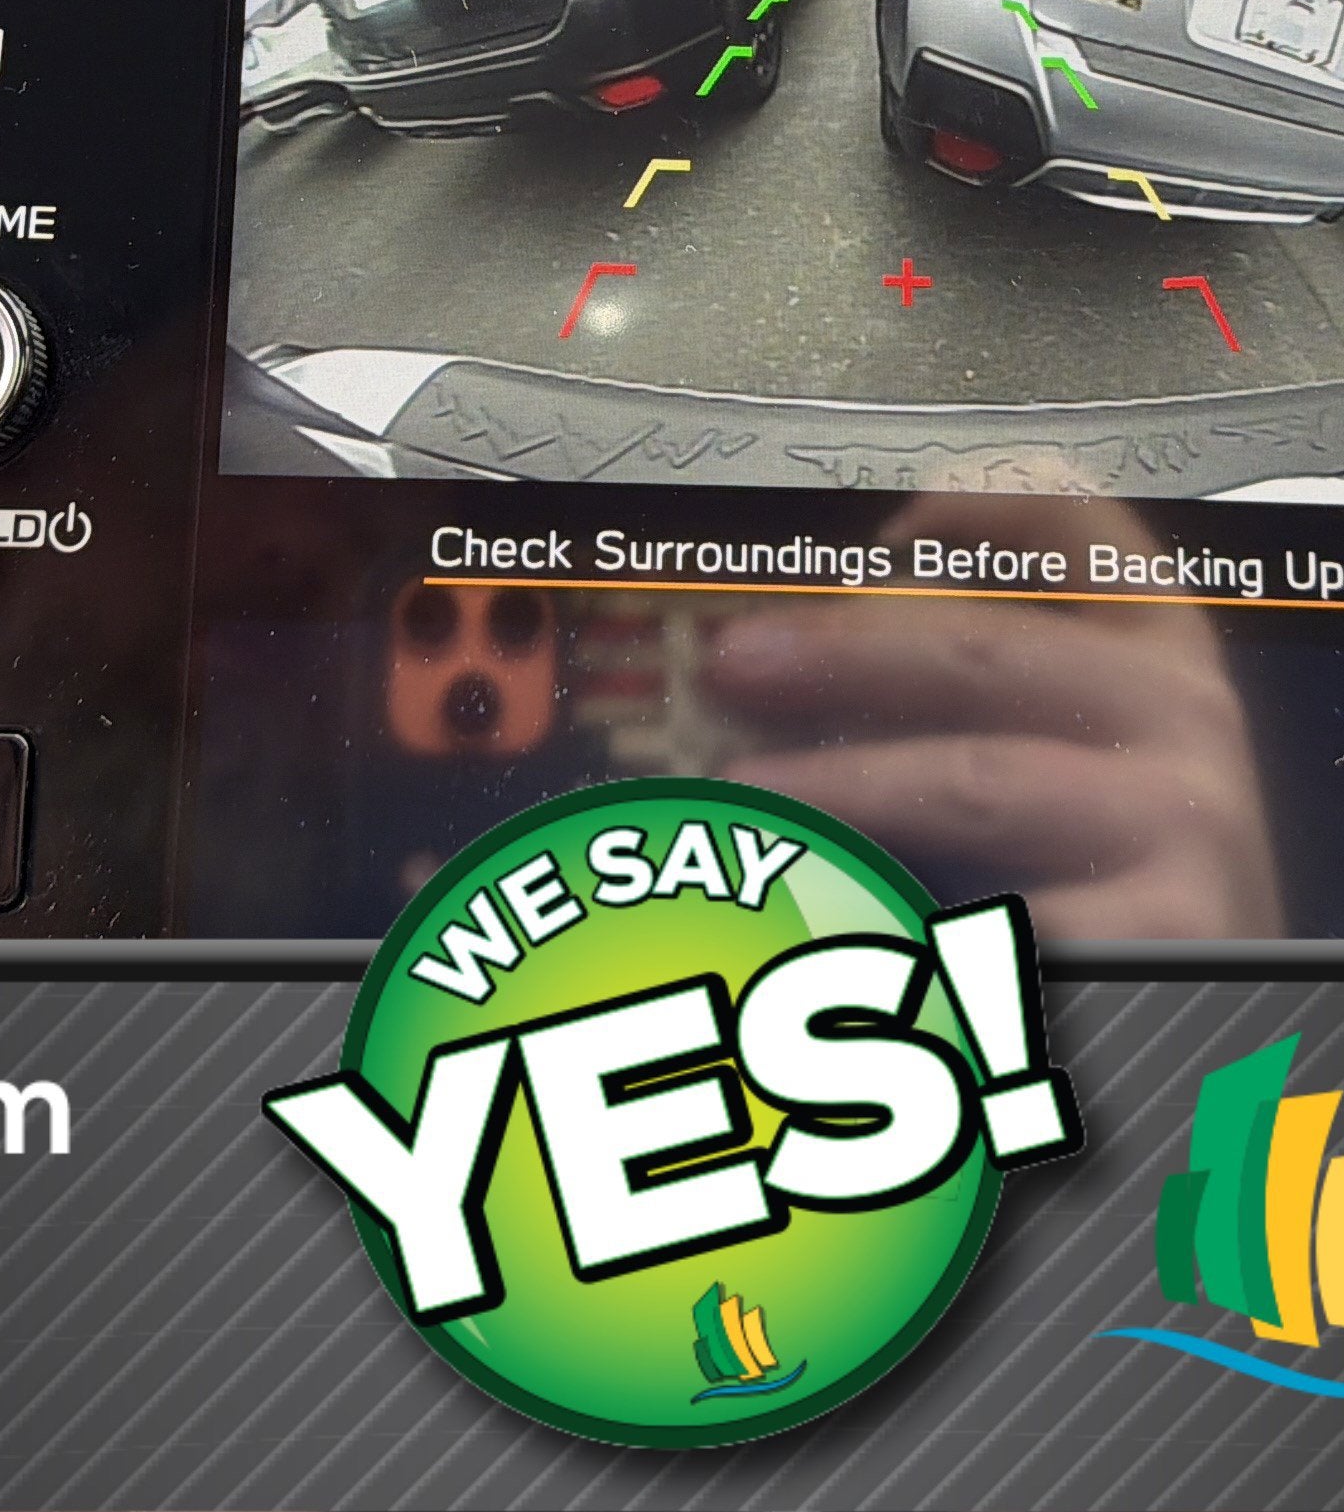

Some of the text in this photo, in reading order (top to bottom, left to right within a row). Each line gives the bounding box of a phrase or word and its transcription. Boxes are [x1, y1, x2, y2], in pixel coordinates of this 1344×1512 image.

[430, 526, 572, 570] Check
[594, 530, 893, 586] Surroundings
[914, 538, 1069, 583] Before
[1090, 545, 1264, 598] Backing
